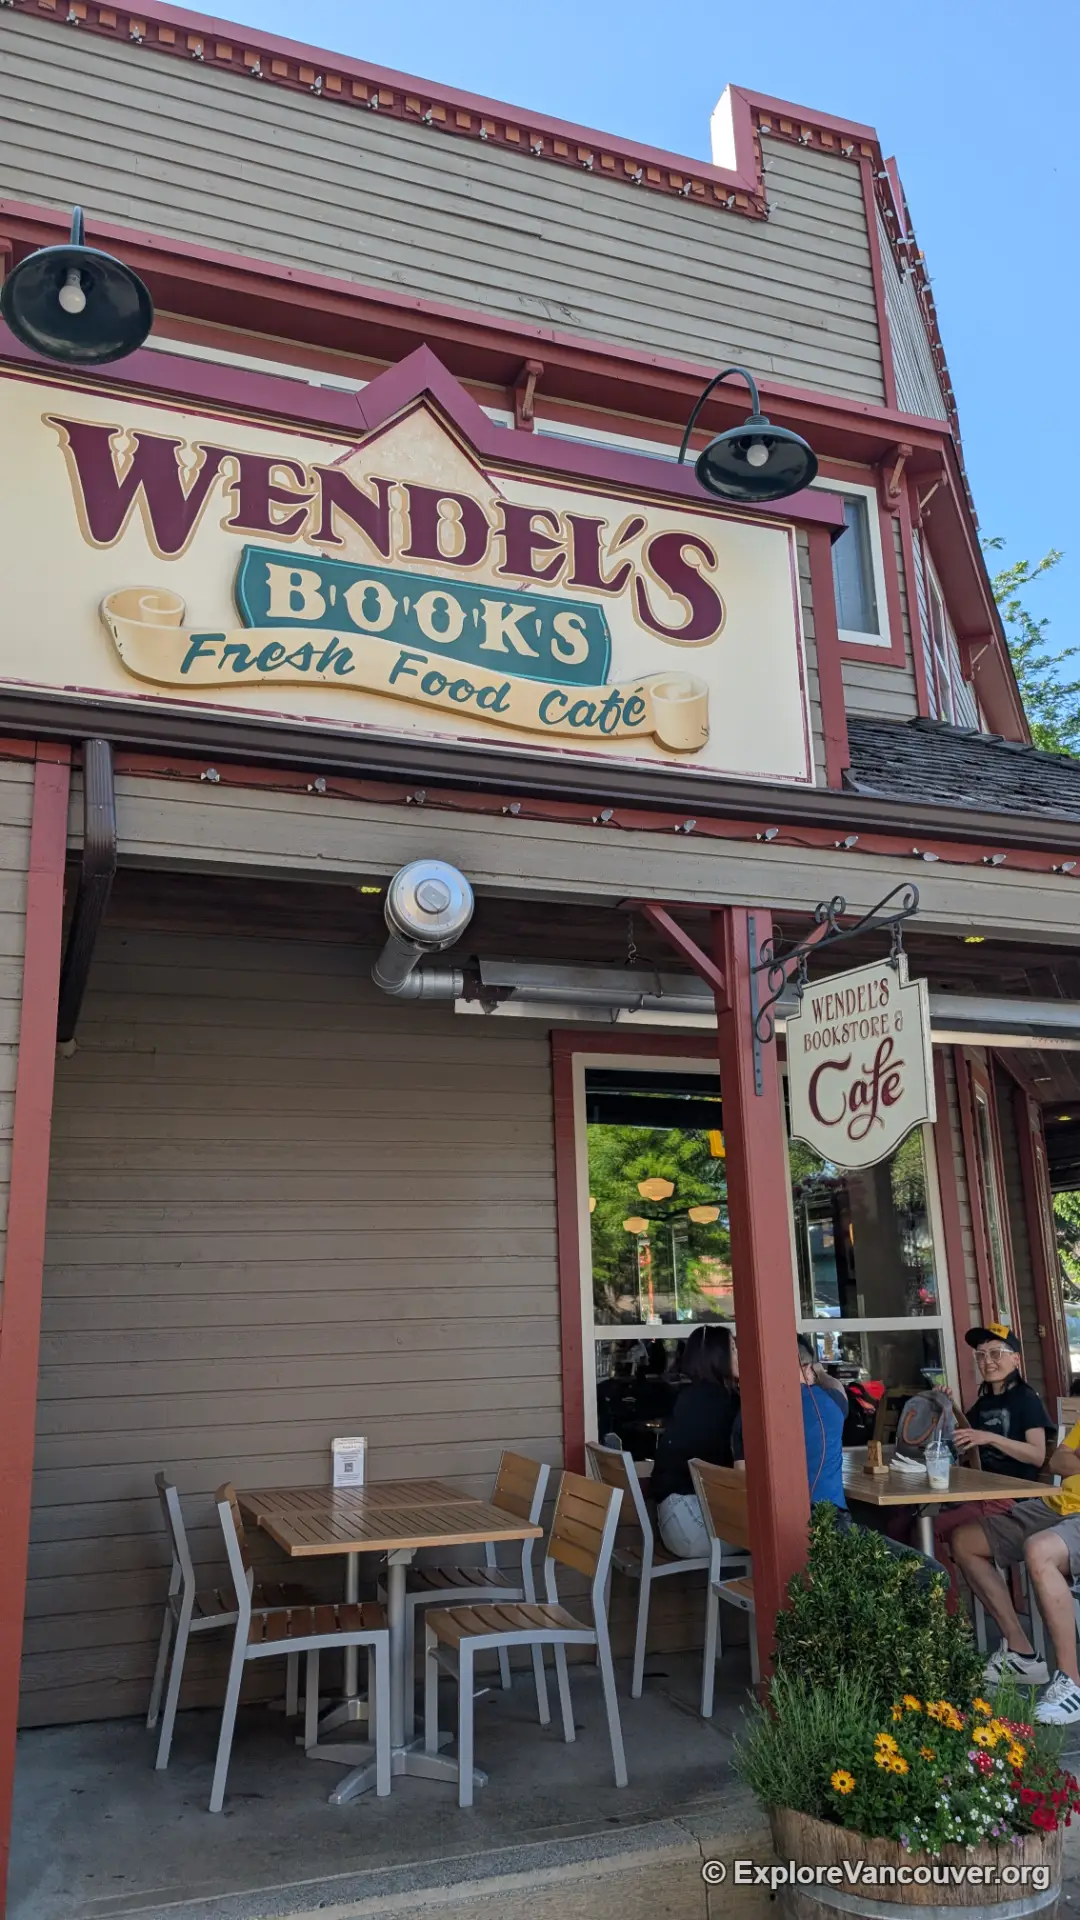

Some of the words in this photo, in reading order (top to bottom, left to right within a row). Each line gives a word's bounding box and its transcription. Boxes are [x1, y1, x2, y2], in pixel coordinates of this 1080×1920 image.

[42, 413, 727, 647] WENDEL'S
[179, 632, 356, 676] Fresh
[388, 650, 512, 713] Food
[538, 686, 647, 734] Café
[803, 1013, 890, 1054] BOOKSTORE
[894, 1010, 904, 1032] &
[811, 977, 890, 1024] WENDEL'S
